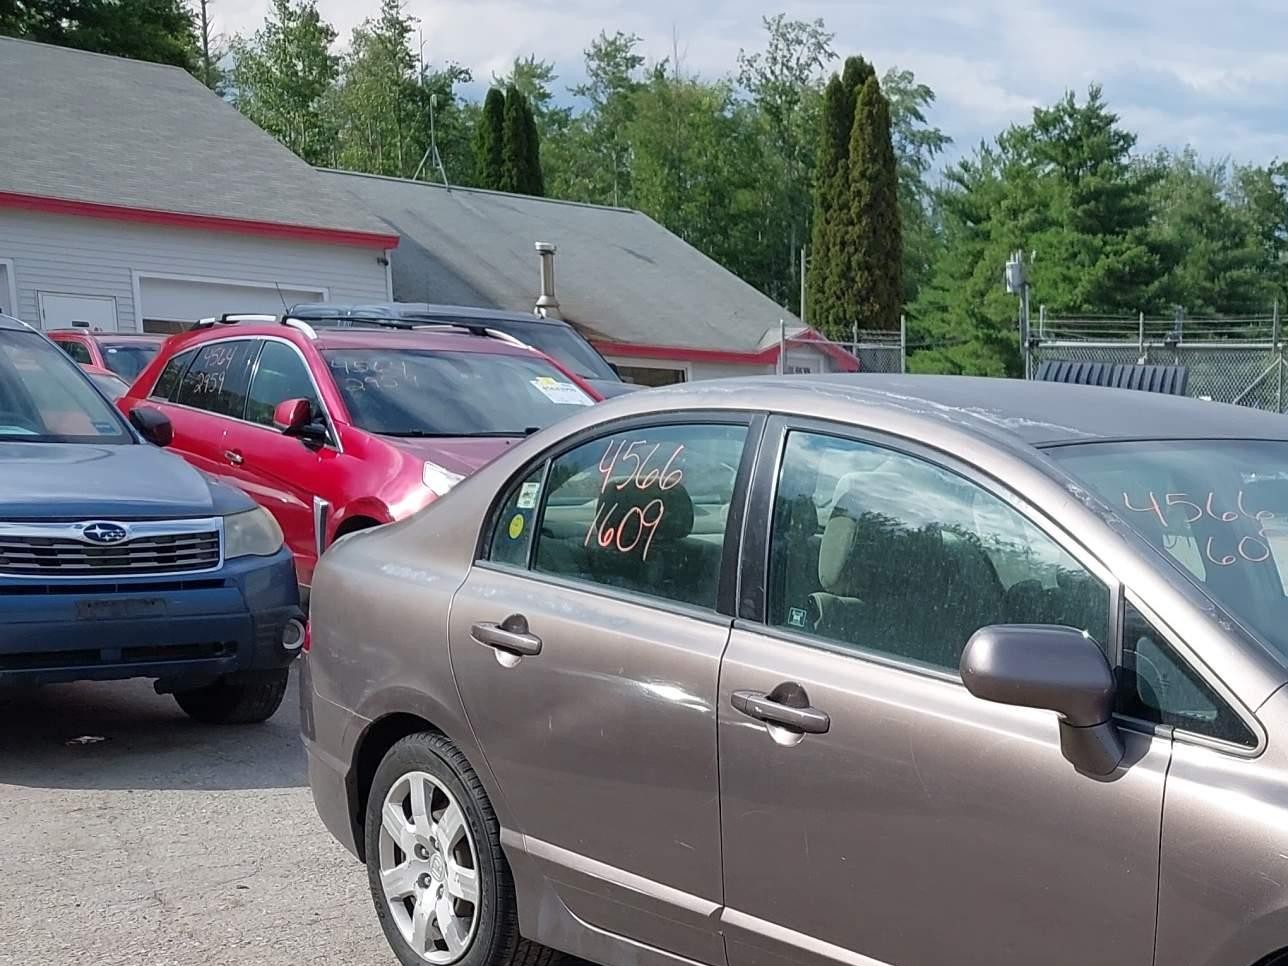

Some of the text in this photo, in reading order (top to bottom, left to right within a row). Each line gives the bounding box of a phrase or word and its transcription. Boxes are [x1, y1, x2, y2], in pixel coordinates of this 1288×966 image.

[193, 371, 225, 395] 2959
[598, 439, 686, 494] 4566
[584, 498, 665, 562] 1609
[1122, 489, 1275, 528] 4566
